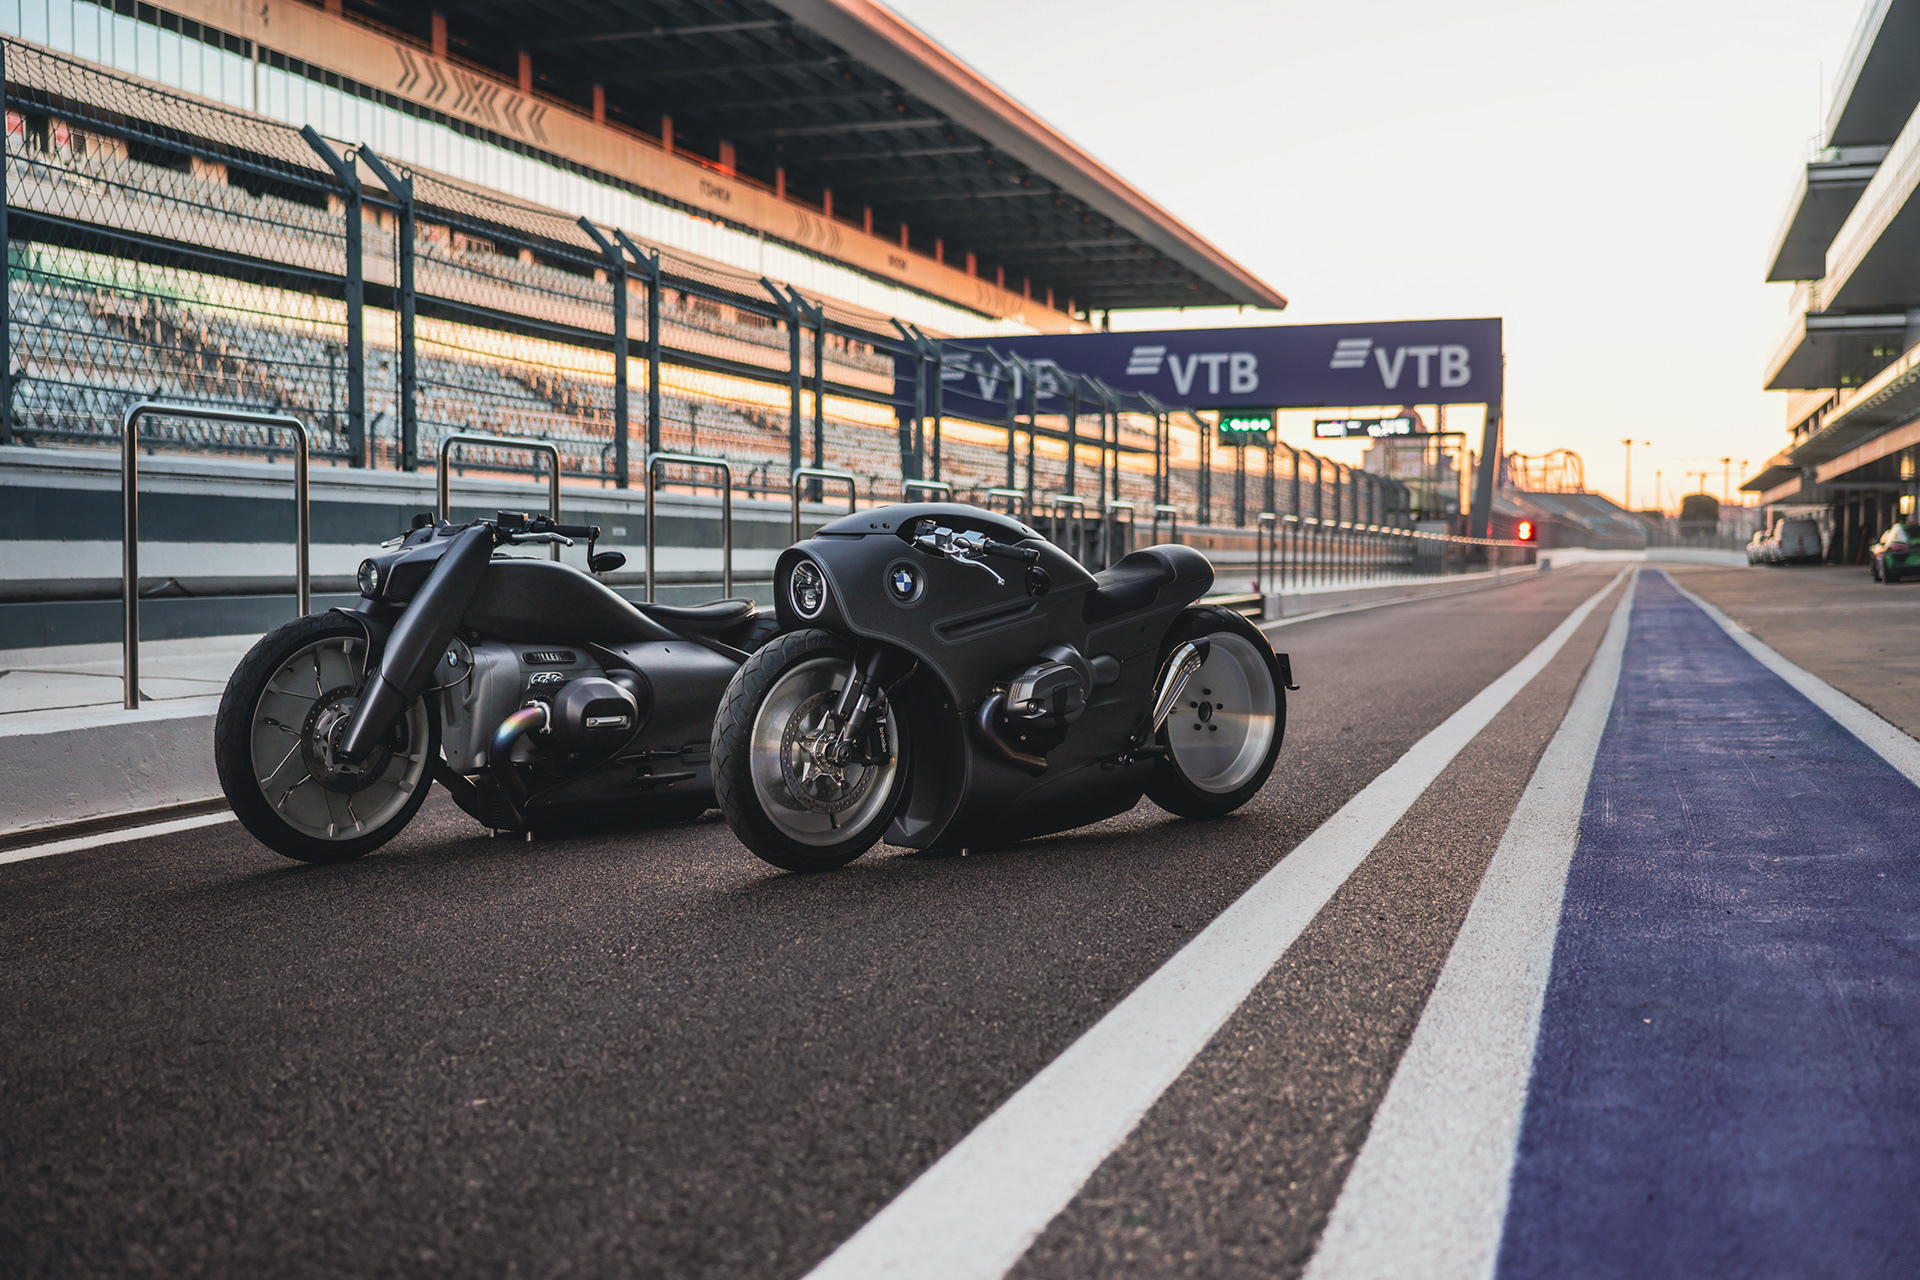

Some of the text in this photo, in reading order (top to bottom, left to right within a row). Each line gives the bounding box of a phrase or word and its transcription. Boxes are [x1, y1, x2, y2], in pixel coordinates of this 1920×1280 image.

[974, 360, 1059, 401] VTB
[1167, 352, 1259, 395] VTB
[1374, 344, 1471, 389] VTB
